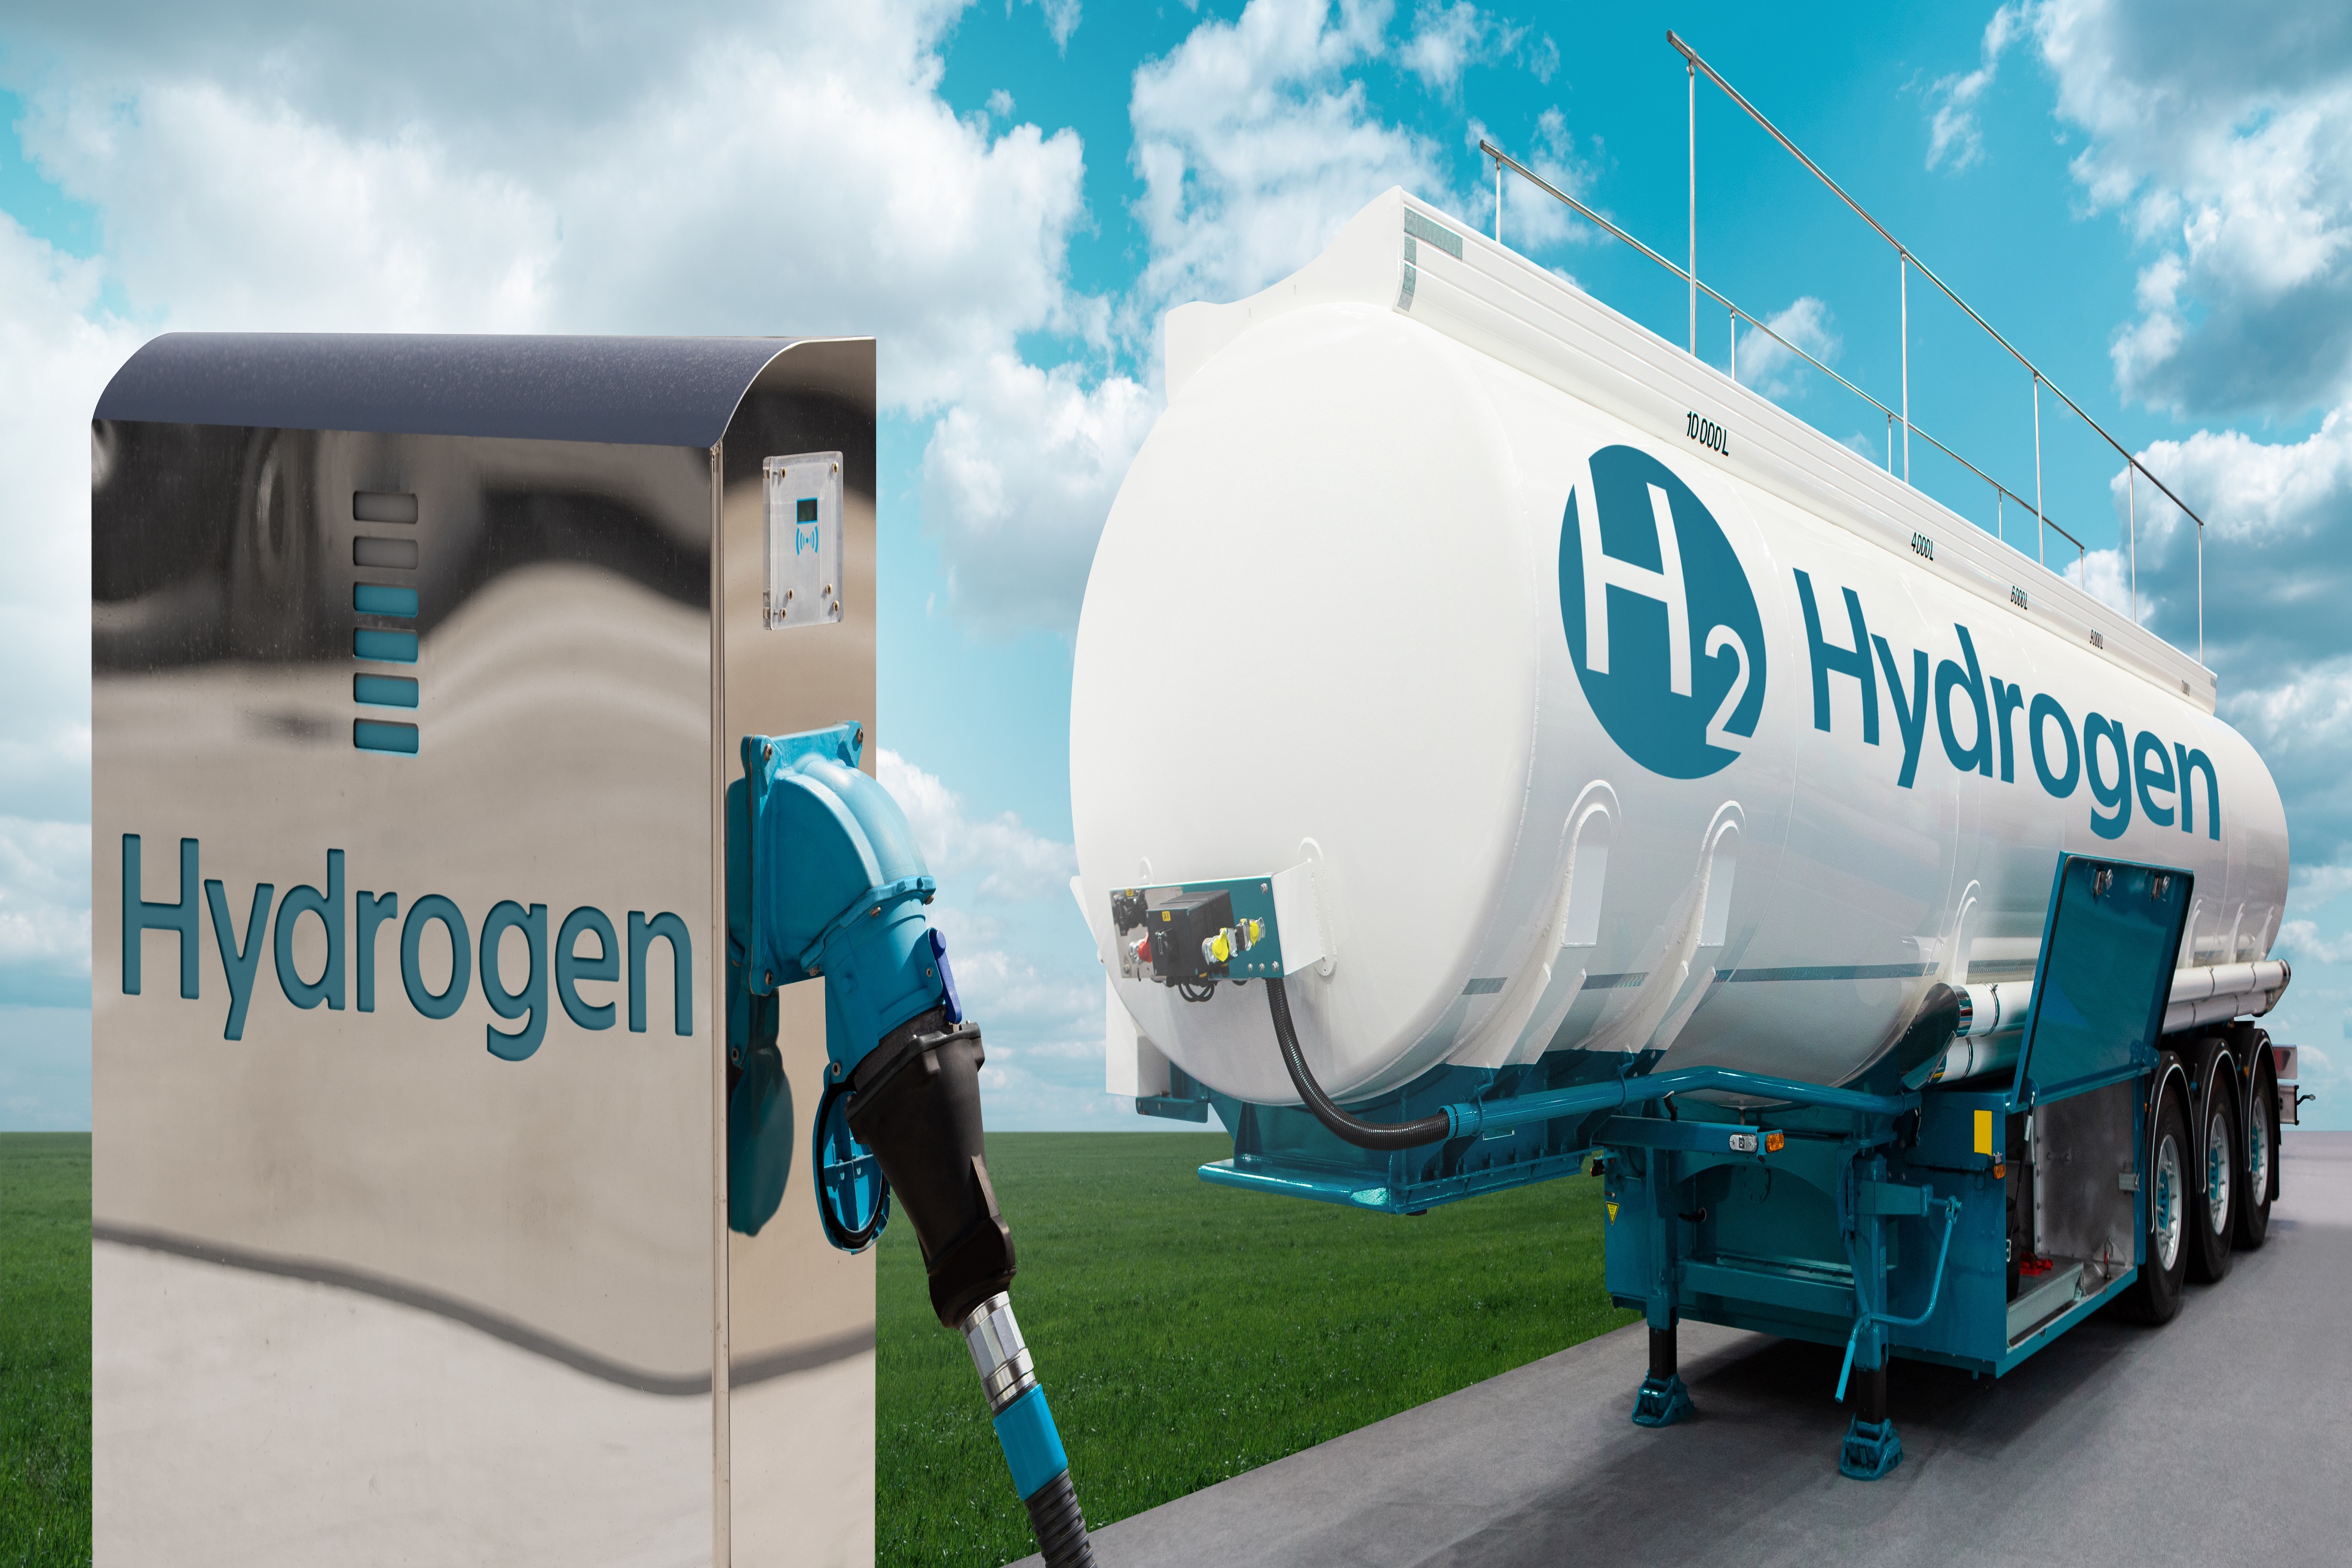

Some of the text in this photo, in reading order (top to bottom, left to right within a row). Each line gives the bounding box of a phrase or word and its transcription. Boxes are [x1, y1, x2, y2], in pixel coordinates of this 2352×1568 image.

[1911, 531, 1934, 562] 4000L
[2010, 585, 2028, 610] 6000L
[1793, 567, 2221, 841] Hydrogen
[122, 833, 693, 1062] Hydrogen
